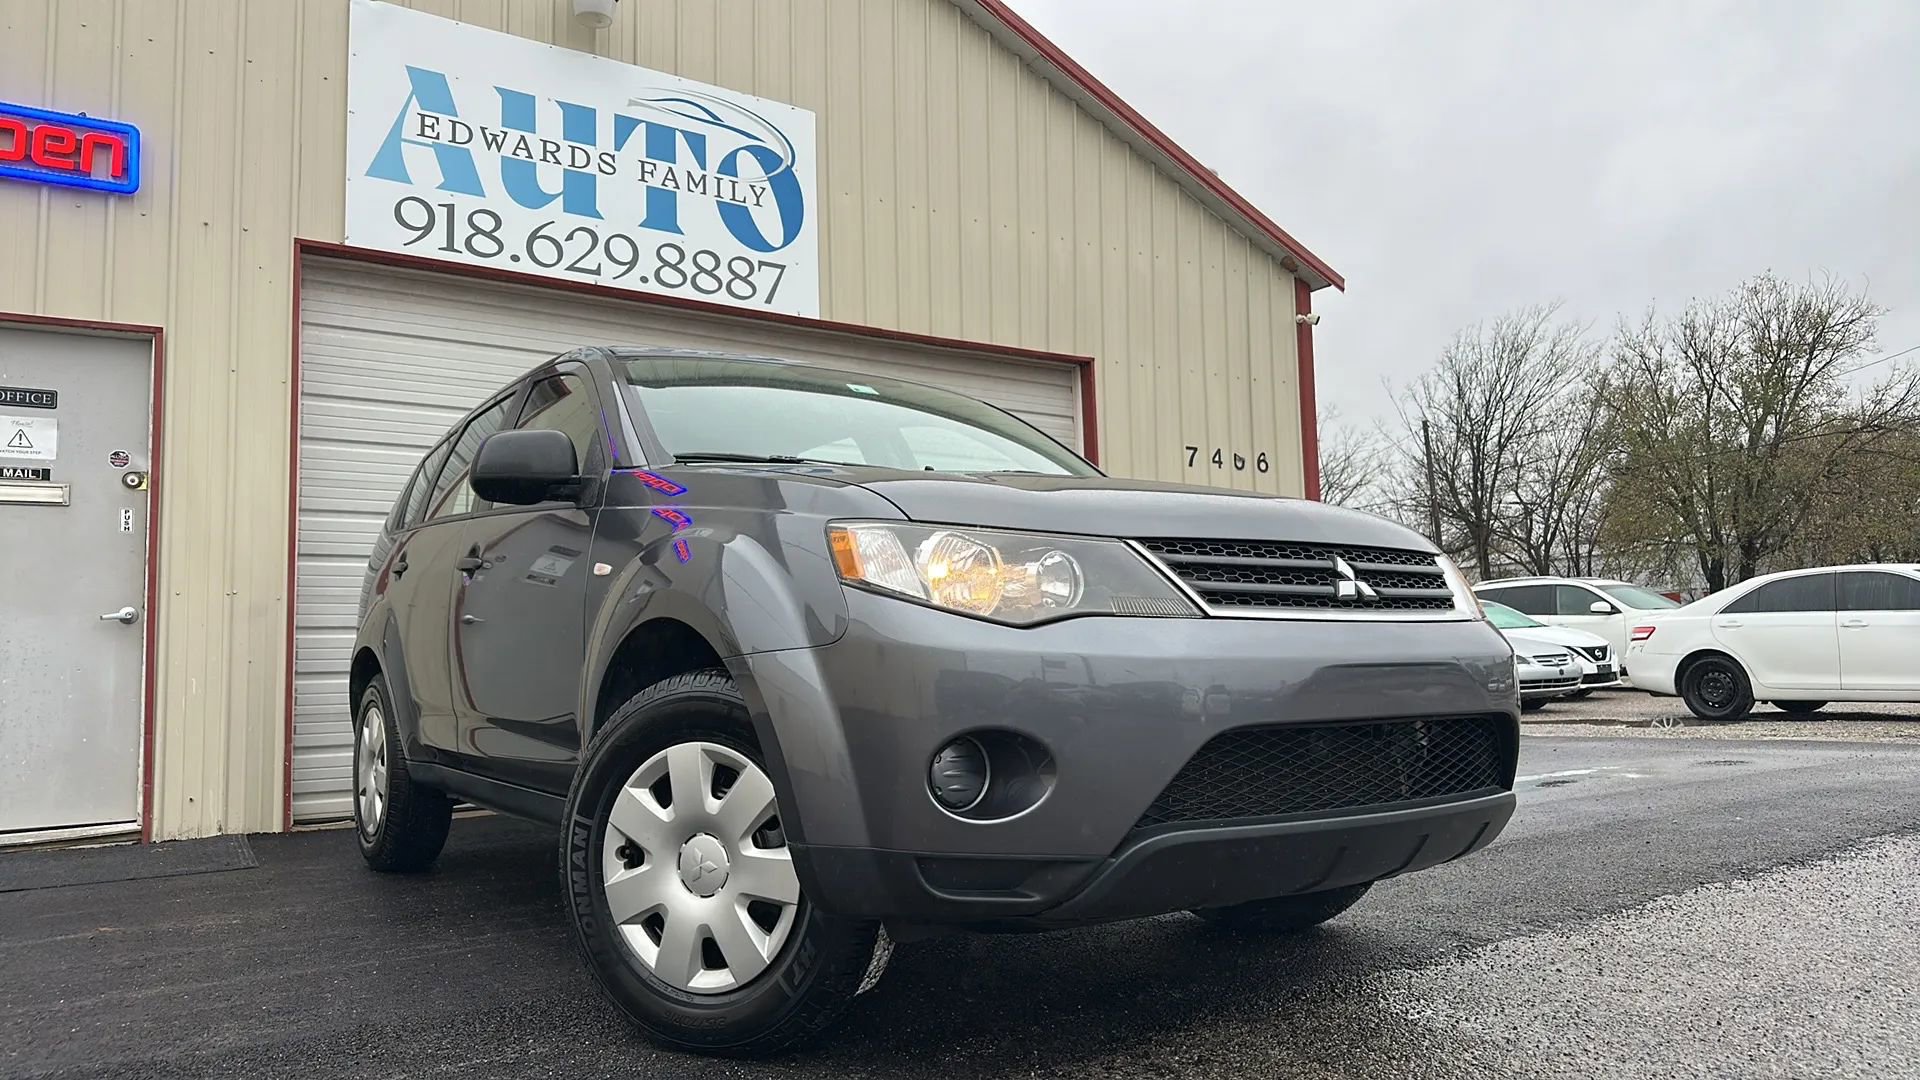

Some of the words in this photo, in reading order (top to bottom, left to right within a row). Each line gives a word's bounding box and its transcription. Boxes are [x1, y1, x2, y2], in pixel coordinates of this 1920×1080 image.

[416, 112, 618, 177] EDWARDS
[637, 159, 767, 208] FAMILY
[393, 195, 787, 306] 918.629.8887
[2, 468, 37, 478] MAIL
